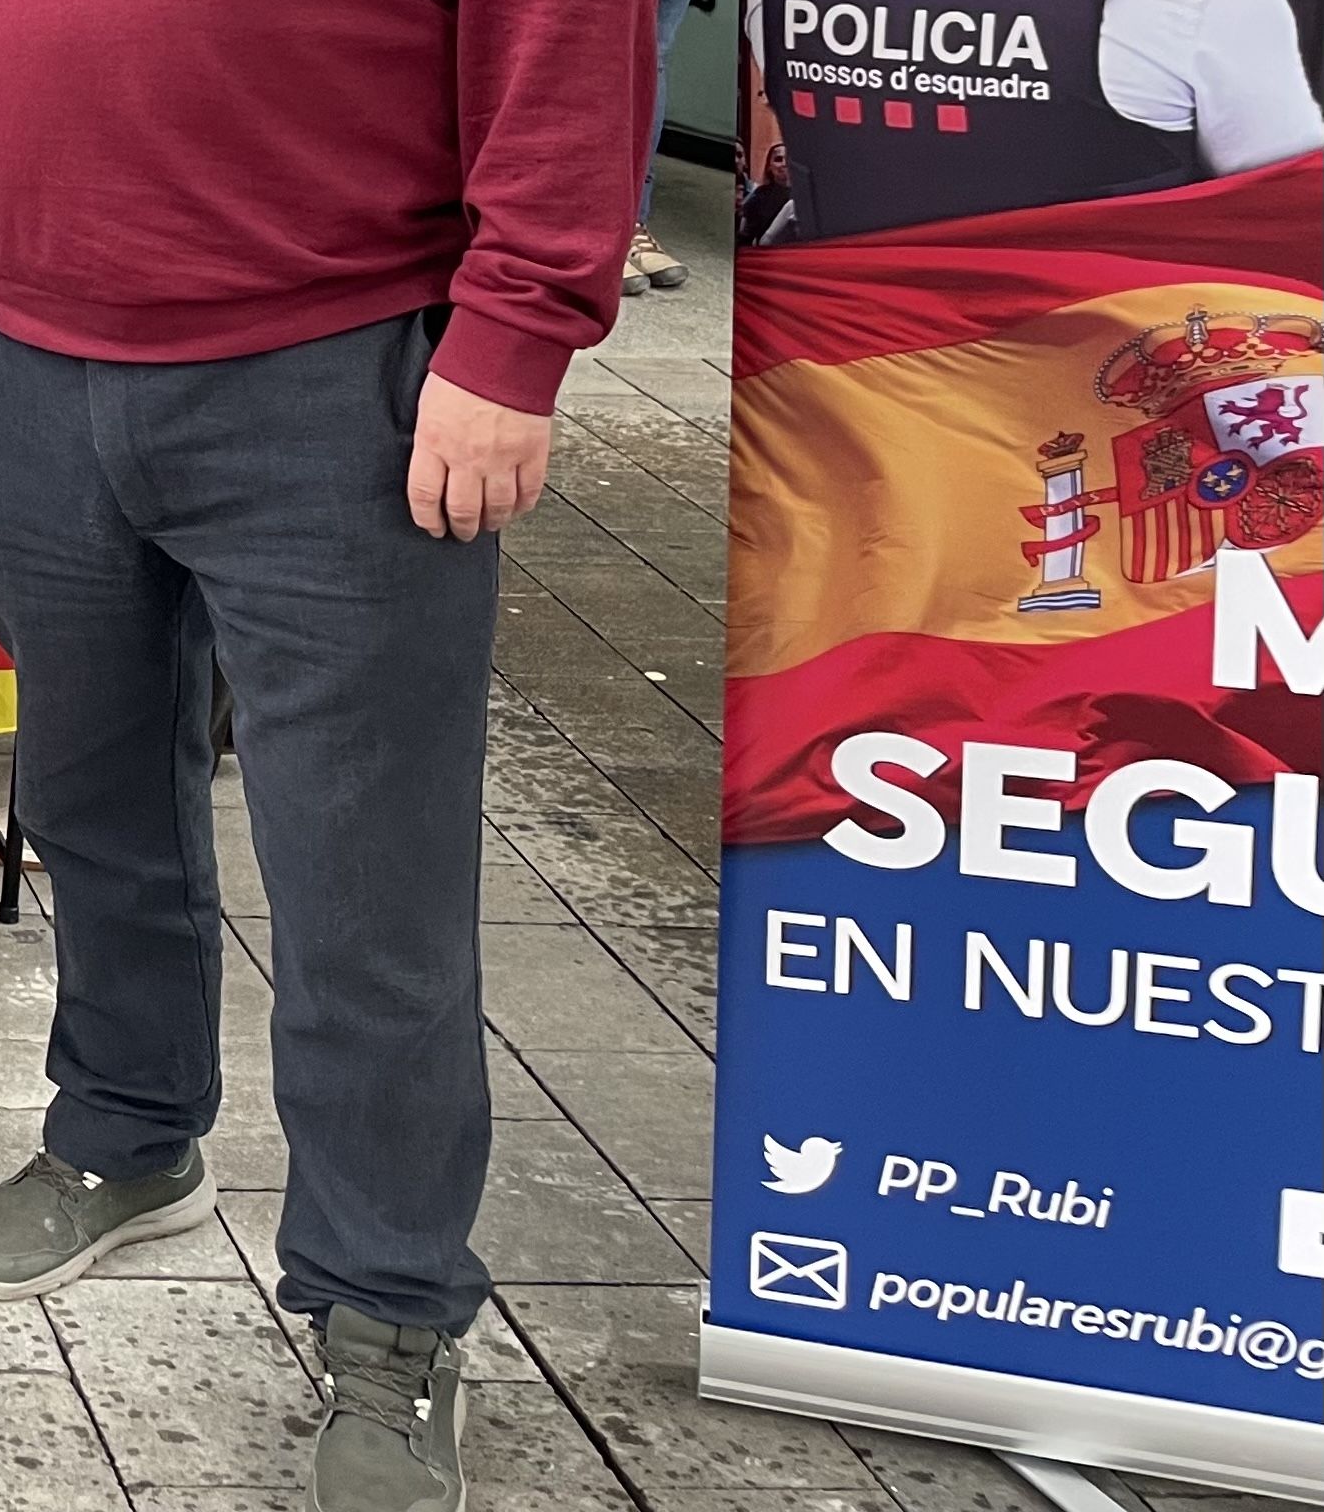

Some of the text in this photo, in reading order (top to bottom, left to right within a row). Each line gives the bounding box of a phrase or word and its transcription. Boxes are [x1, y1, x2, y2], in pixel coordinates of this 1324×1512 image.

[786, 60, 883, 88] mossos
[766, 909, 1324, 1054] EN NUEST
[878, 1155, 1114, 1229] PP_Rubi
